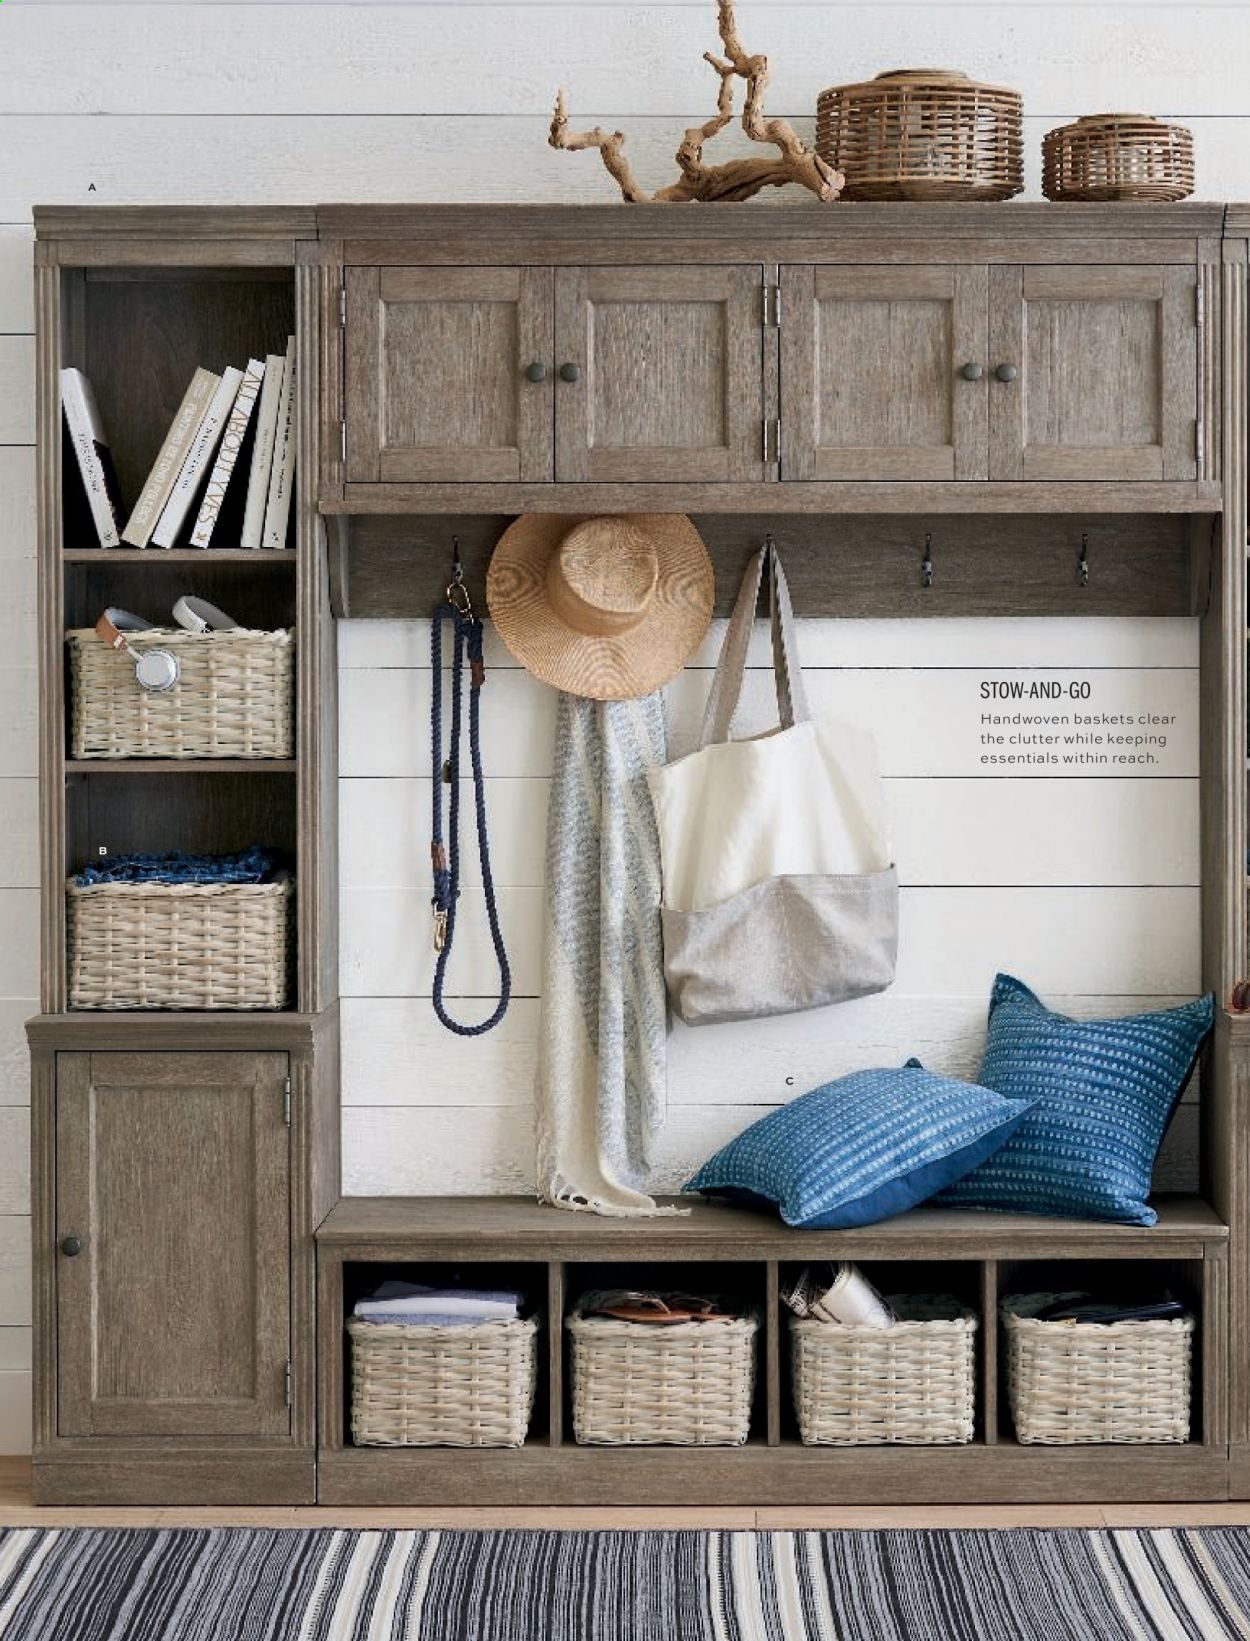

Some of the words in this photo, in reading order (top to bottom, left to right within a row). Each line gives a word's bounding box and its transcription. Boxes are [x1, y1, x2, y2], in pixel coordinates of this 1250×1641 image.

[236, 369, 263, 402] ALL
[213, 406, 251, 474] ABOUT
[197, 475, 230, 526] YVES
